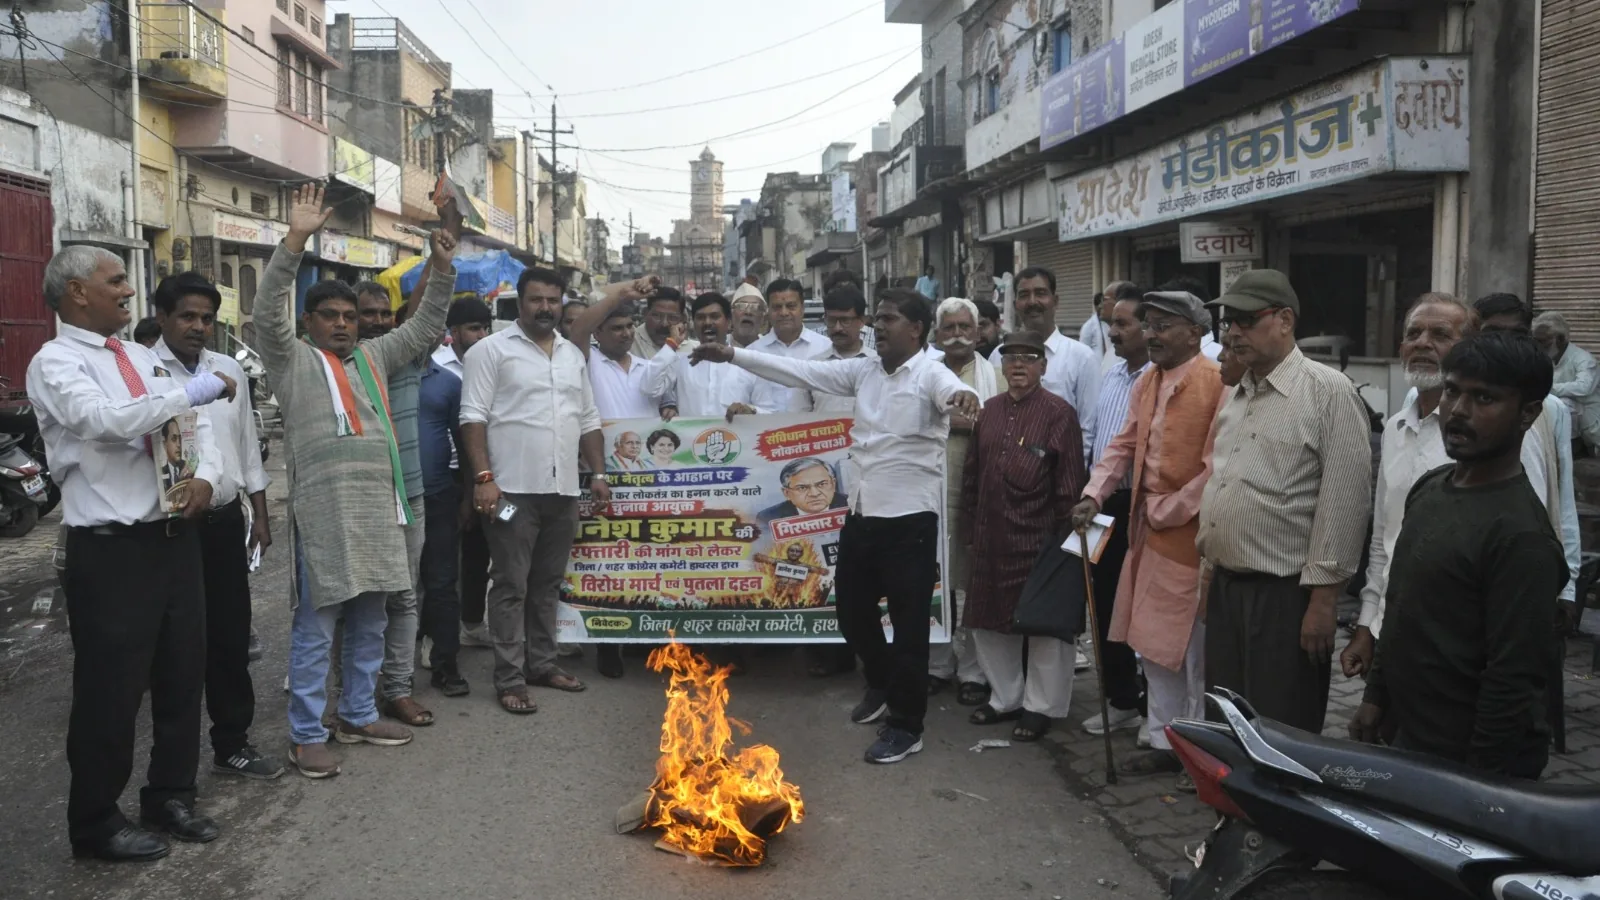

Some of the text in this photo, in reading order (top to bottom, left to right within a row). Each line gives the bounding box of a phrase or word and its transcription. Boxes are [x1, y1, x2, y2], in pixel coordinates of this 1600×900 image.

[1198, 1, 1240, 31] MYCODERM
[1142, 26, 1163, 50] ADESH
[1130, 46, 1157, 75] MEDICAL
[1157, 38, 1178, 62] STORE
[1075, 160, 1152, 225] आदेश
[1256, 174, 1266, 190] के
[1193, 226, 1255, 255] दवायें
[766, 421, 845, 445] संविधान बचाओ
[771, 435, 847, 458] लोकतंत्र बचाओ
[622, 472, 655, 487] नेतृत्व
[657, 471, 671, 483] के
[717, 470, 735, 480] पर
[615, 491, 630, 500] कर
[633, 489, 668, 500] लोकतंत्र
[670, 490, 684, 499] का
[687, 490, 711, 499] हनन
[713, 486, 740, 497] करने
[741, 485, 762, 496] वाले
[612, 502, 649, 516] चुनाव
[652, 500, 696, 515] आयुक्त
[648, 517, 737, 542] कुमार
[735, 526, 754, 539] की
[777, 516, 833, 537] गिरफ्तार
[634, 545, 652, 557] की
[655, 544, 681, 558] मांग
[686, 544, 703, 557] को
[707, 544, 742, 557] लेकर
[574, 561, 596, 572] जिला
[605, 563, 624, 572] शहर
[627, 559, 658, 571] कांग्रेस
[660, 559, 687, 571] कमेटी
[721, 561, 739, 571] द्वारा
[581, 572, 764, 595] विरोध मार्च एवं पुतला दहन
[639, 614, 672, 632] जिला
[683, 619, 713, 635] शहर
[717, 614, 762, 632] कांग्रेस
[765, 613, 807, 634] कमेटी,
